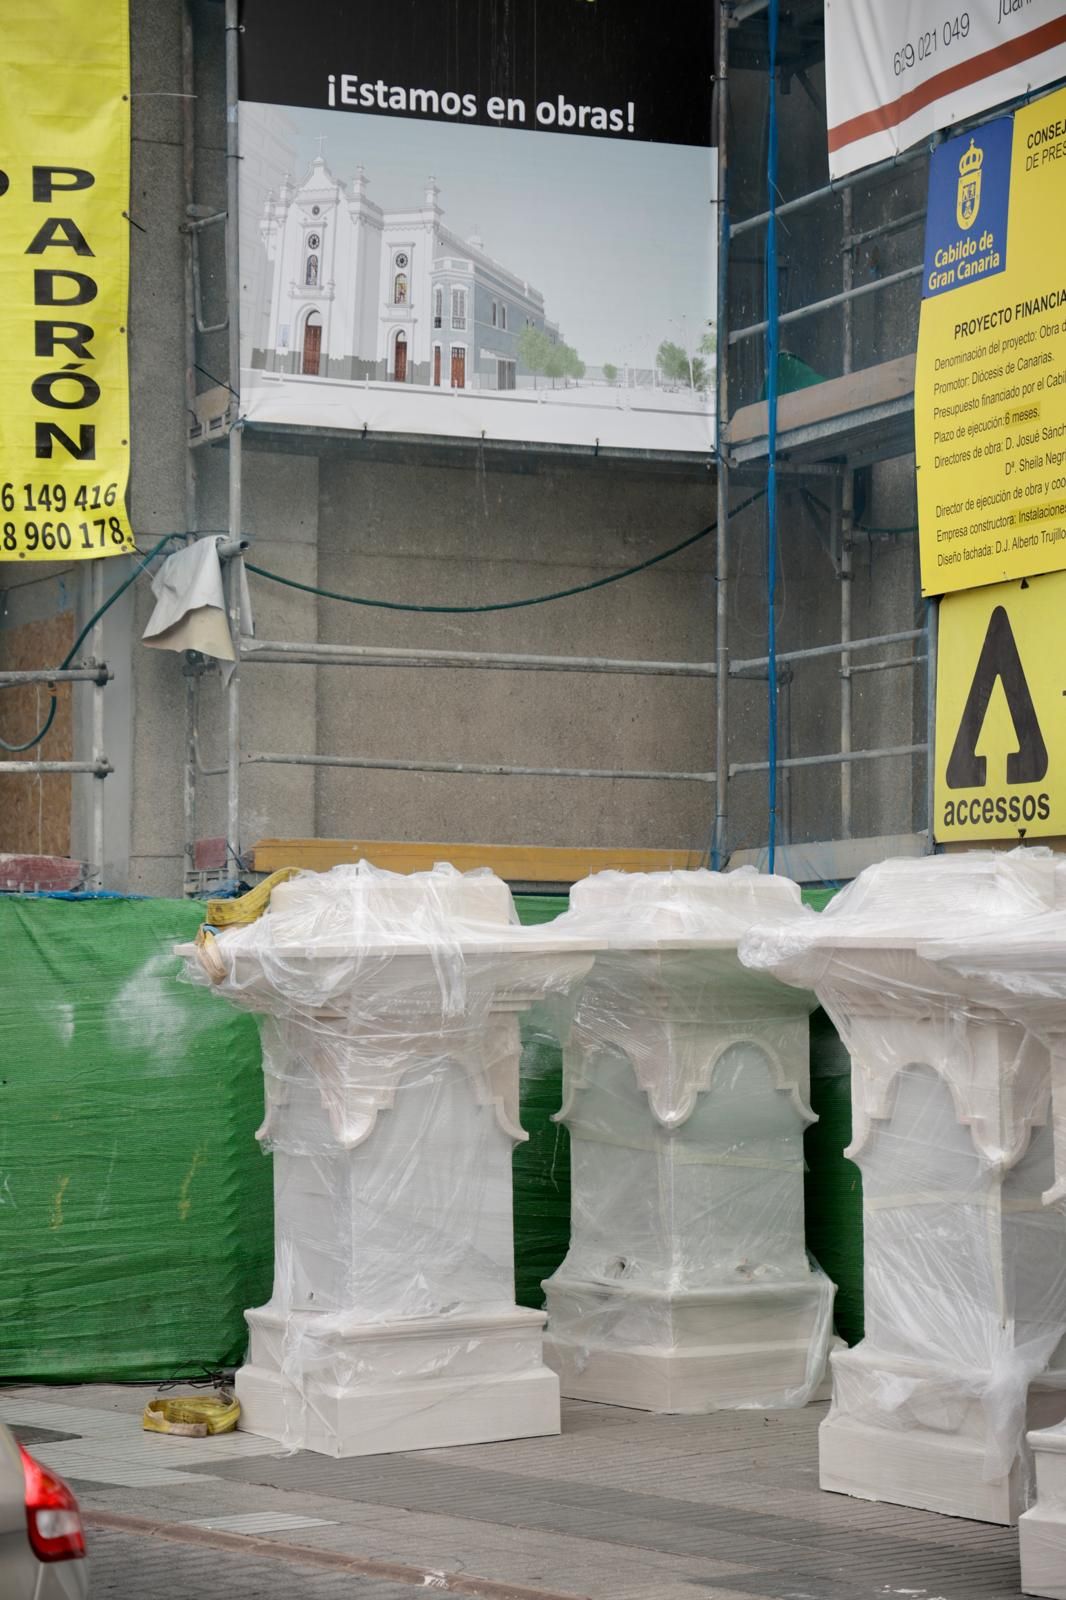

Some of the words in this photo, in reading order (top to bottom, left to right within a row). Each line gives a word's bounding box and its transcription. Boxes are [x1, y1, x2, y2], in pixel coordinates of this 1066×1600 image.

[918, 29, 937, 61] 021
[943, 12, 970, 46] 049
[328, 73, 477, 117] ¡Estamos
[486, 95, 526, 122] en
[536, 94, 635, 133] obras!
[1026, 152, 1039, 172] DE
[934, 236, 977, 268] Cabildo
[979, 230, 993, 251] de
[928, 269, 955, 290] Gran
[957, 249, 1000, 280] Canaria
[24, 165, 101, 461] PADRÓN
[954, 307, 1012, 340] PROYECTO
[934, 345, 987, 371] Denominación
[989, 340, 1001, 355] del
[1002, 330, 1037, 354] proyecto:
[1039, 323, 1059, 339] Obra
[933, 376, 970, 395] Promotor:
[972, 366, 1004, 385] Diócesis
[1005, 361, 1015, 375] de
[1017, 351, 1055, 371] Canarias.
[933, 397, 980, 420] Presupuesto
[981, 386, 1020, 407] financiado
[1022, 382, 1036, 398] por
[1037, 376, 1044, 391] el
[933, 430, 955, 445] Plazo
[956, 426, 966, 439] de
[1012, 407, 1040, 423] meses.
[934, 449, 971, 469] Directores
[972, 446, 982, 459] de
[984, 441, 1003, 457] obra:
[1005, 437, 1014, 450] D.
[1016, 429, 1040, 448] Josué
[1019, 455, 1043, 472] Sheila
[23, 483, 67, 513] 149
[74, 483, 118, 512] 416
[935, 502, 964, 518] Director
[964, 498, 974, 511] de
[976, 489, 1011, 511] ejecución
[1013, 486, 1022, 500] de
[1024, 483, 1042, 497] obra
[1044, 481, 1049, 495] y
[0, 521, 17, 551] 8
[24, 521, 72, 551] 960
[78, 516, 125, 549] 178
[936, 525, 968, 543] Empresa
[969, 514, 1016, 535] constructora:
[937, 550, 961, 567] Diseño
[963, 544, 993, 561] fachada:
[1011, 534, 1039, 550] Alberto
[943, 793, 1051, 827] accessos
